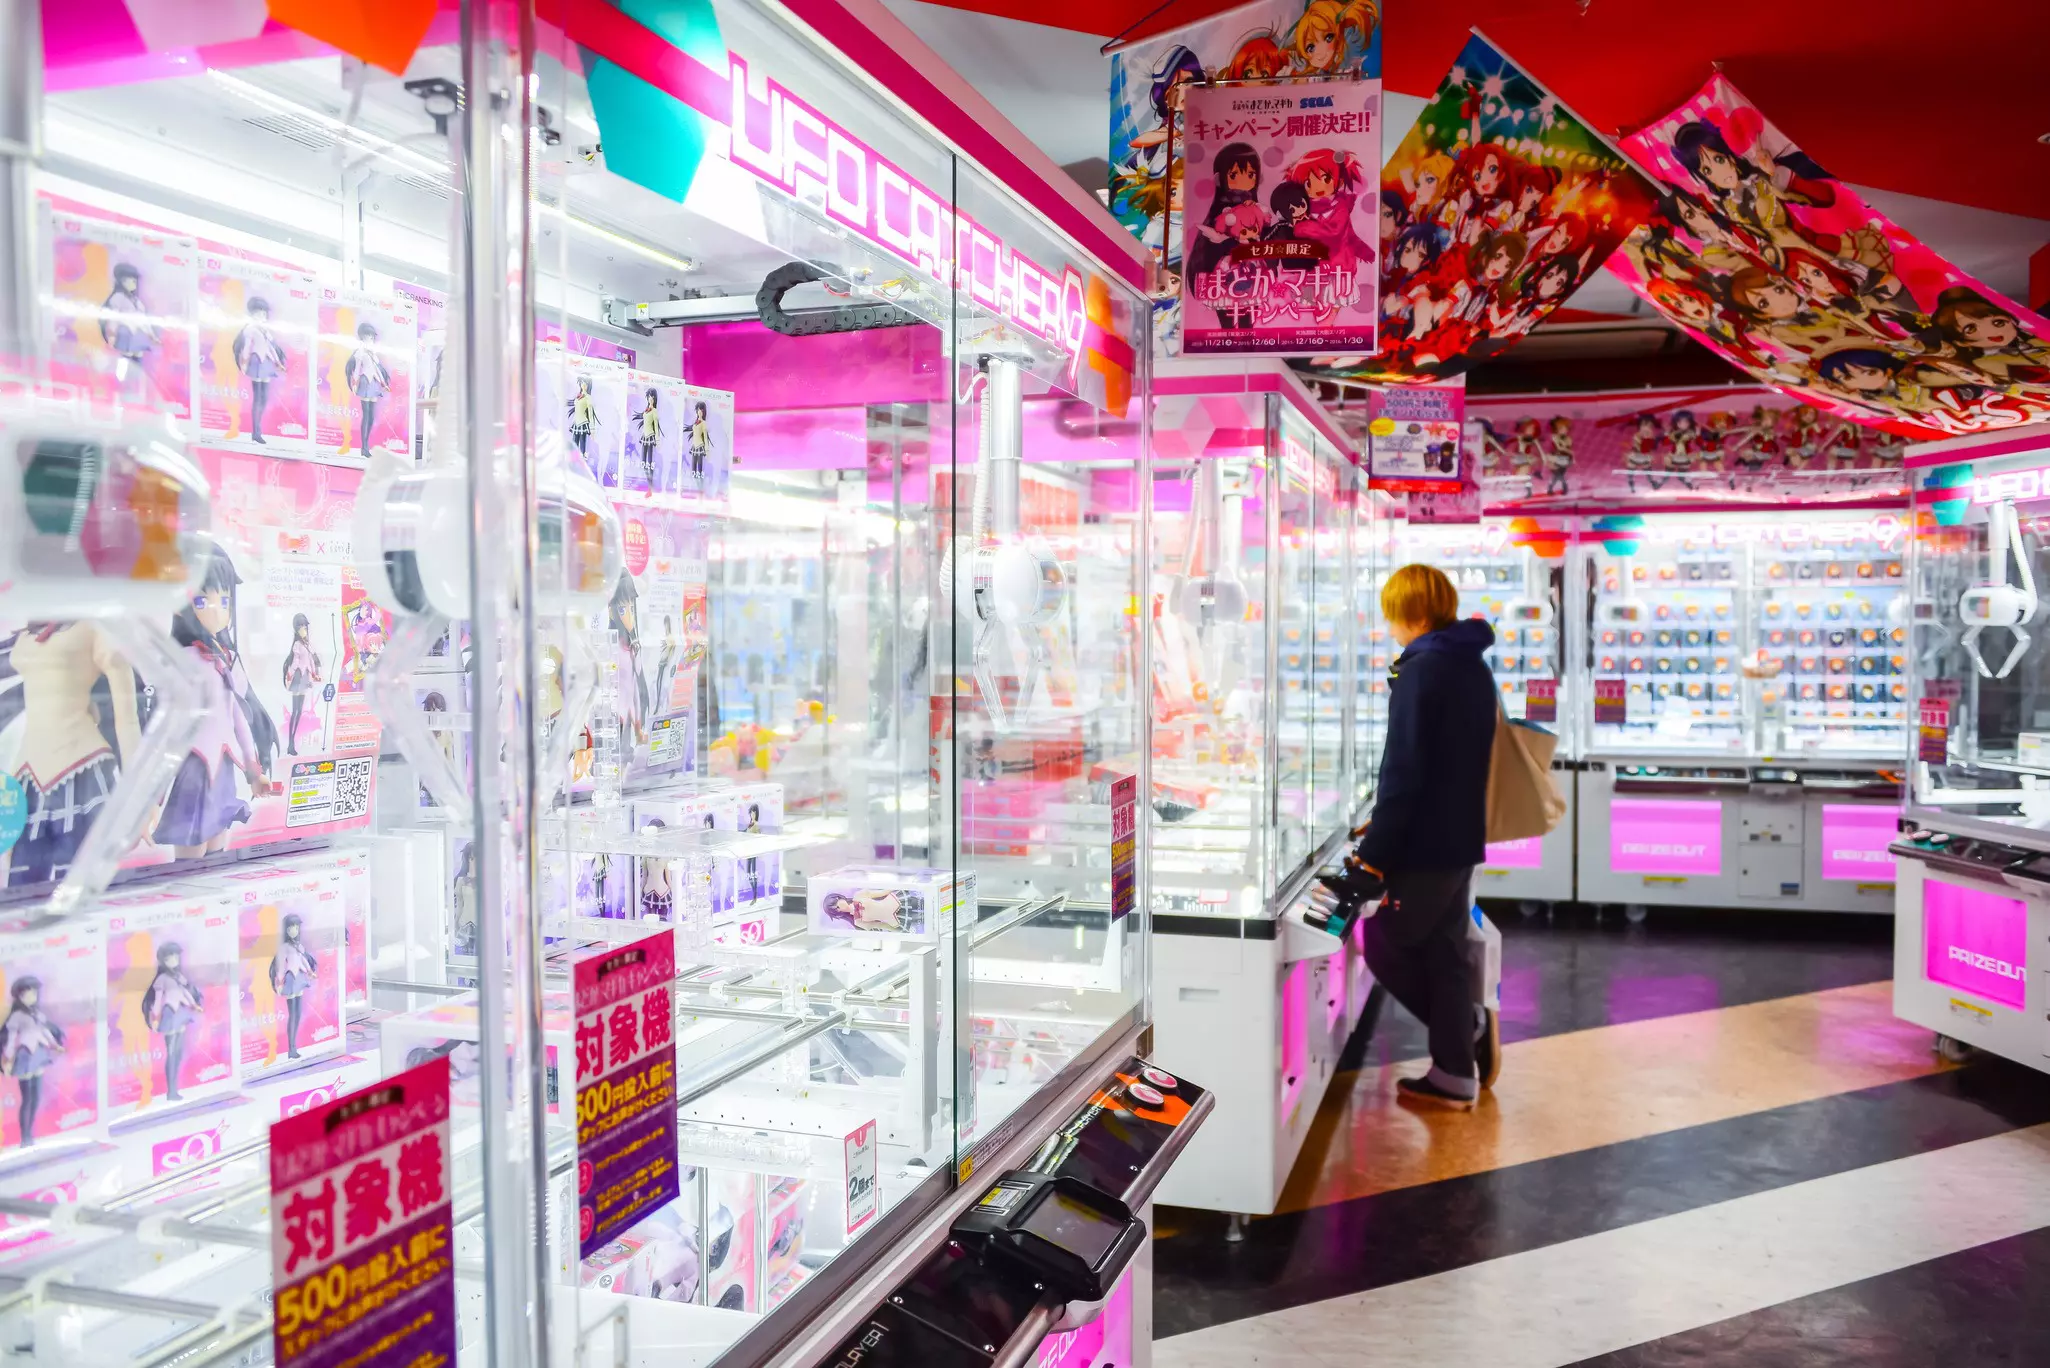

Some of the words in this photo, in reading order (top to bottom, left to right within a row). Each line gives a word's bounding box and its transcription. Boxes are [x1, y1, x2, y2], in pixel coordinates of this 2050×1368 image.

[1193, 111, 1371, 141] キャンペーン開催決定!!
[1299, 95, 1334, 109] SEGA
[729, 58, 868, 230] UFO
[876, 160, 1061, 342] CATCHER
[1061, 264, 1088, 388] 9
[1226, 301, 1332, 327] キャンペーン
[575, 986, 671, 1084] 対象機
[283, 1130, 443, 1277] 対象機
